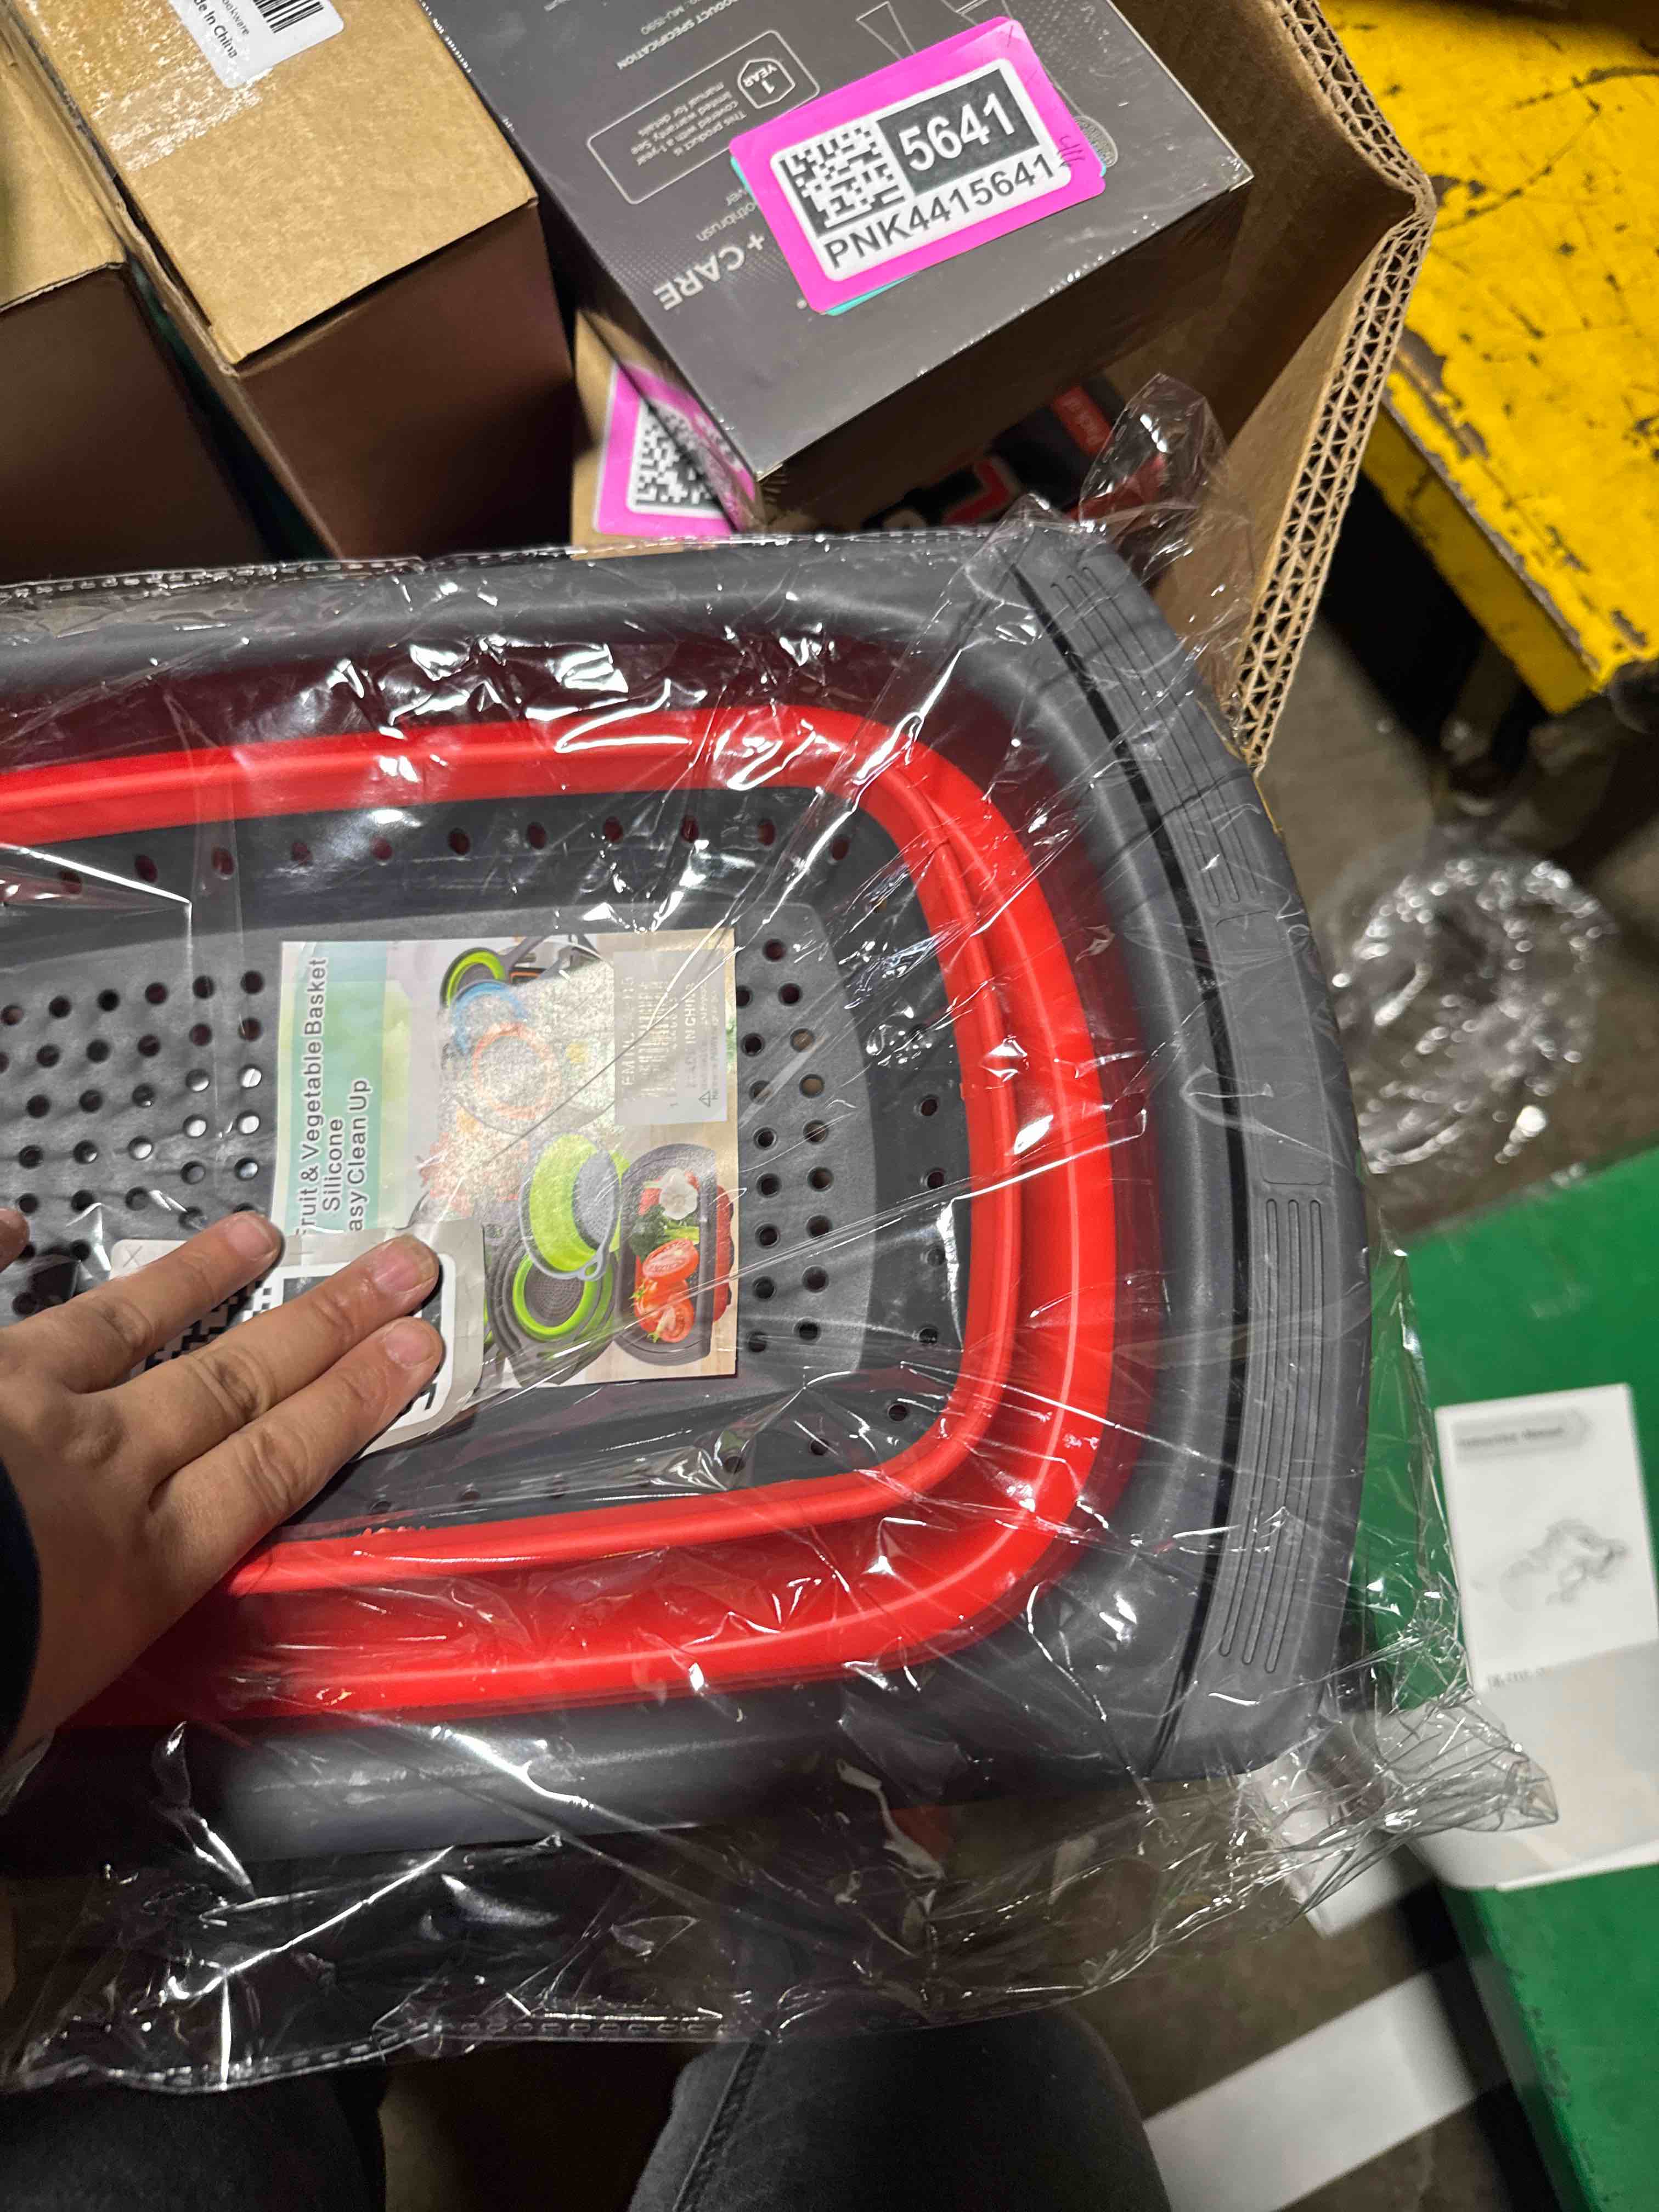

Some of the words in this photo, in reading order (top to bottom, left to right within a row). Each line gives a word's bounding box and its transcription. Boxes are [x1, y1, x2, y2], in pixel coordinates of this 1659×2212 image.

[222, 0, 250, 35] ookware
[696, 0, 738, 24] ODUCT
[204, 10, 216, 25] In
[214, 25, 237, 58] China
[617, 19, 695, 70] SPECIFICATION
[743, 65, 777, 87] YEAR
[761, 80, 775, 94] 1
[673, 105, 688, 116] for
[689, 82, 724, 106] manual
[697, 91, 733, 116] limited
[697, 100, 738, 129] covered
[631, 140, 652, 155] See
[674, 125, 697, 142] with
[685, 121, 724, 151] product
[898, 92, 1015, 171] 5641
[696, 201, 756, 241] othbrush
[823, 153, 1054, 269] PNK4415641
[652, 245, 744, 311] CARE
[304, 957, 326, 1035] Basket
[301, 1041, 324, 1160] Vegetable
[349, 1079, 372, 1111] Up
[323, 1118, 343, 1211] Silicone
[347, 1117, 366, 1184] Clean
[300, 1165, 319, 1182] &
[349, 1190, 368, 1231] asy
